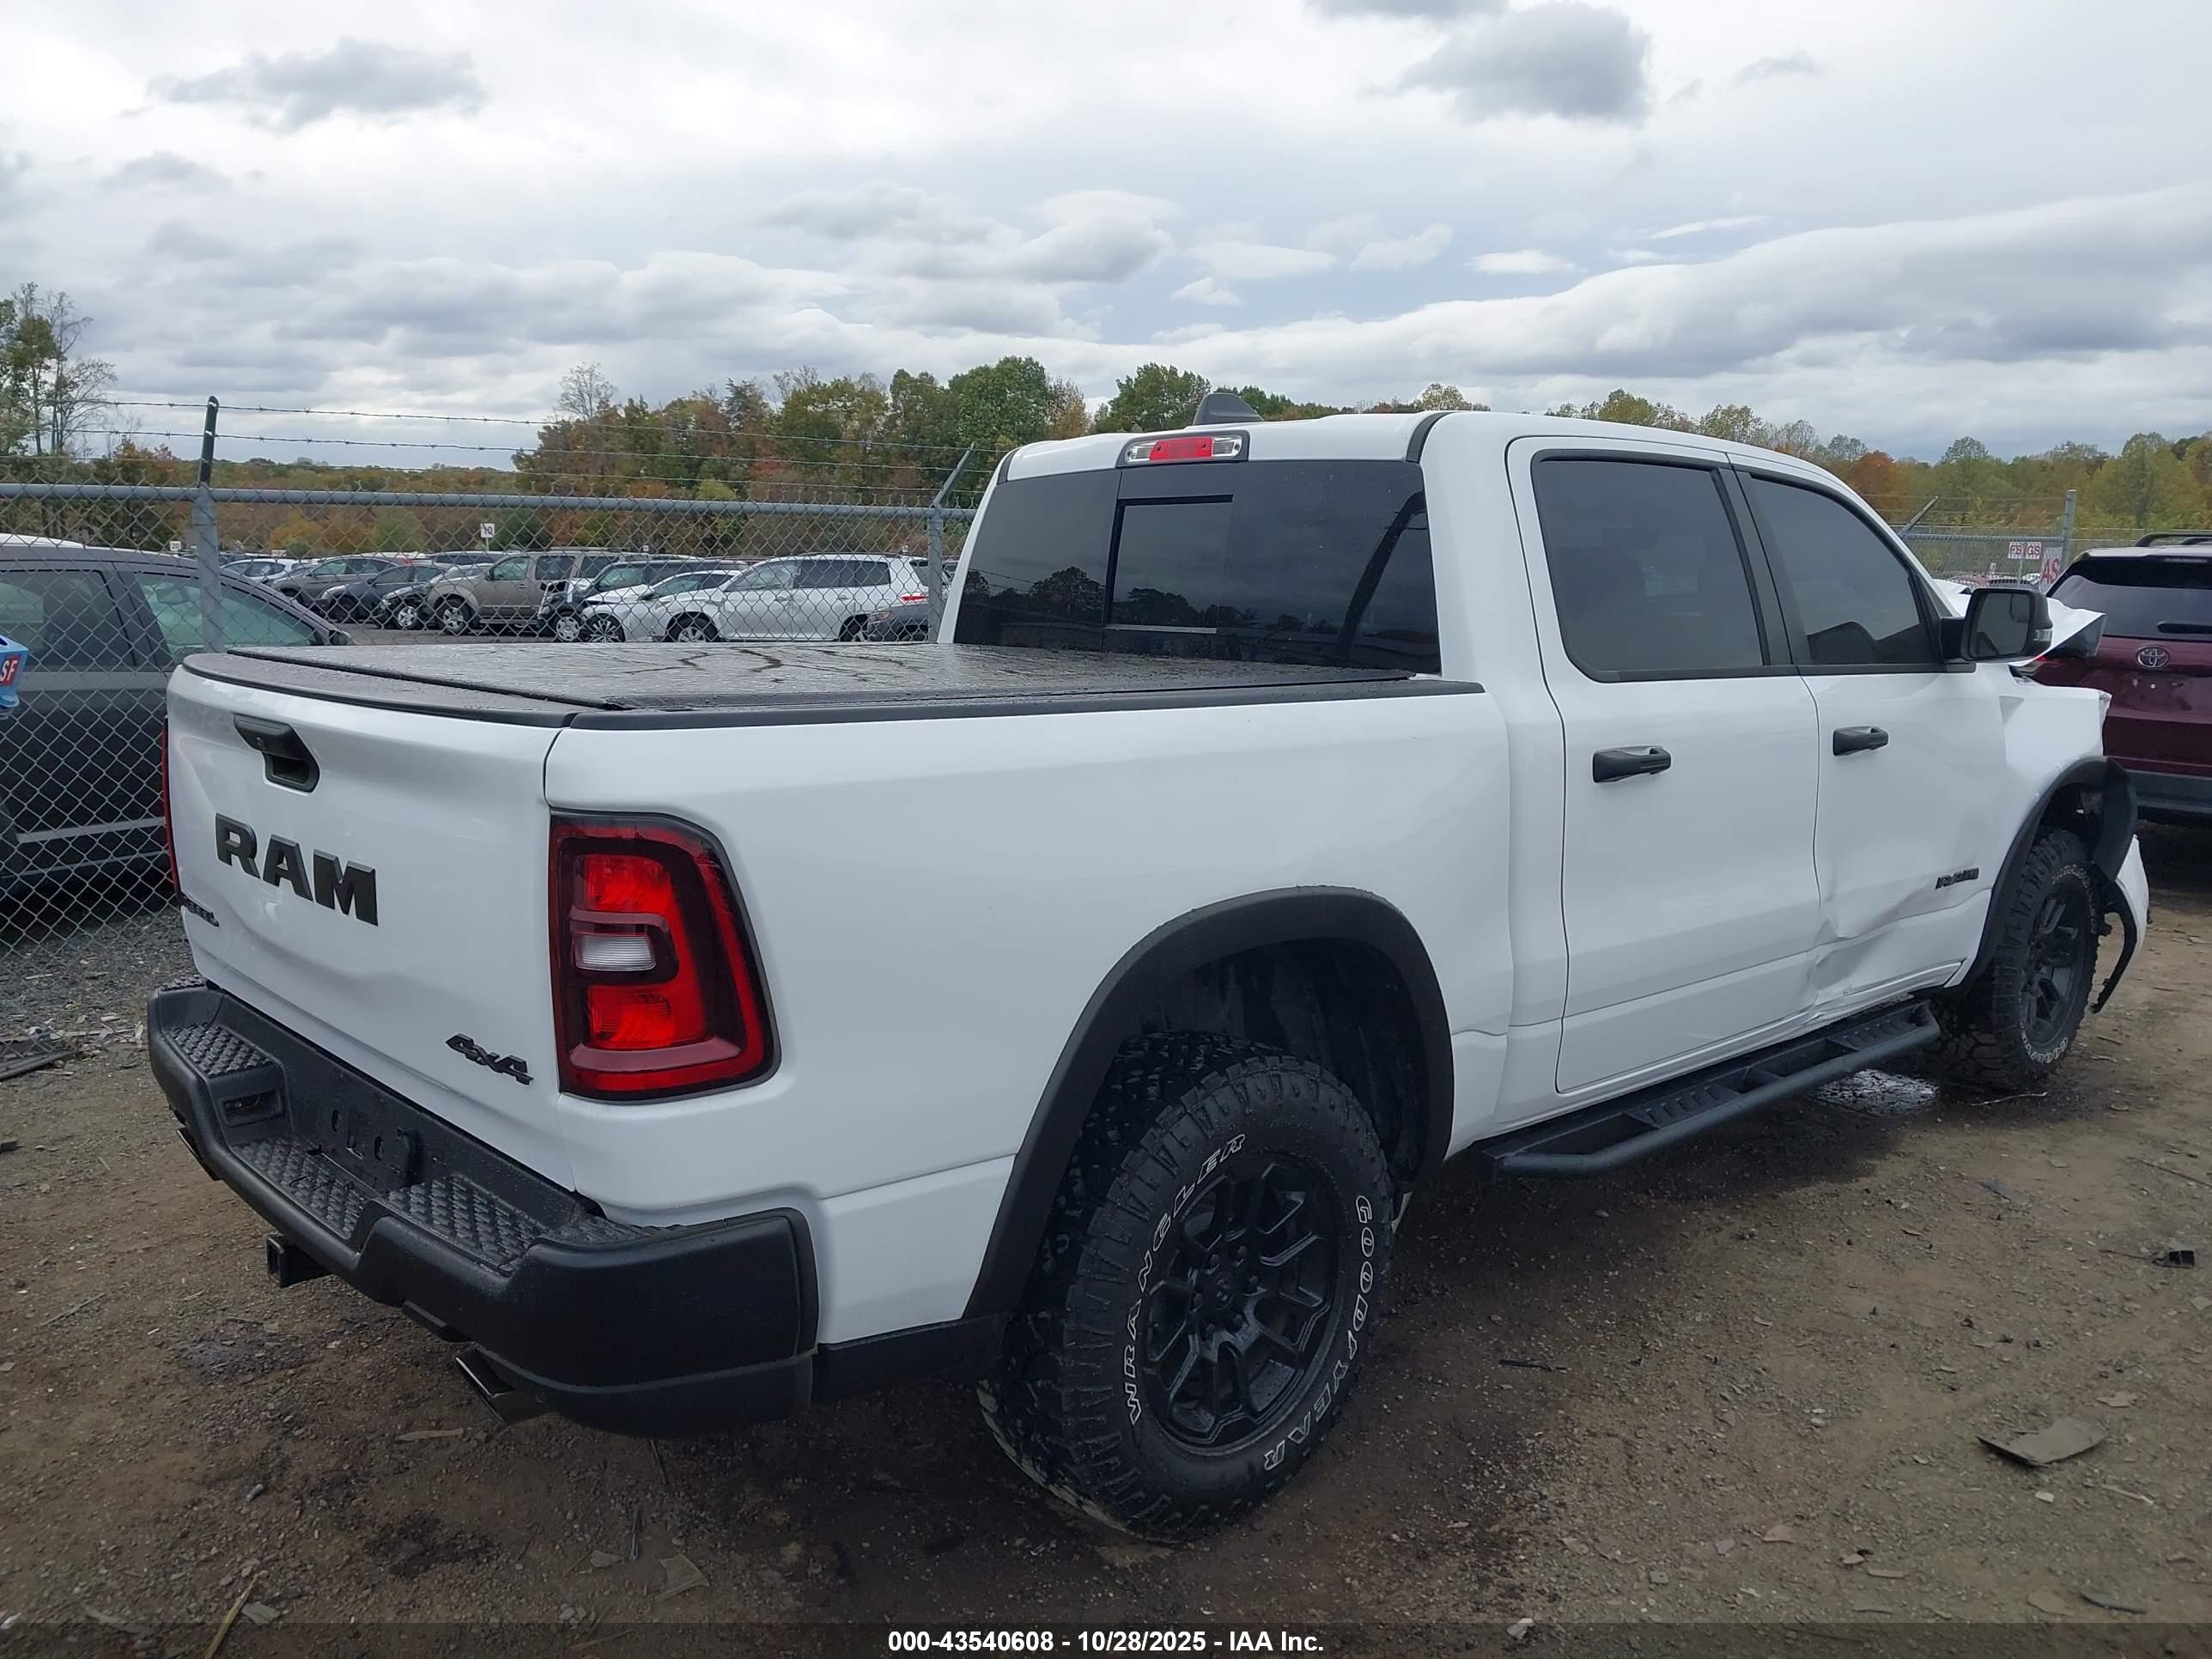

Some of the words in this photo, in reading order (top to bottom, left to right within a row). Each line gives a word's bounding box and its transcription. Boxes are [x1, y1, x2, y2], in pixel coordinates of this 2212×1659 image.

[2027, 545, 2041, 556] GS
[215, 811, 379, 927] RAM
[1122, 1133, 1247, 1427] WRANGLER
[1263, 1195, 1375, 1472] GOODYEAR
